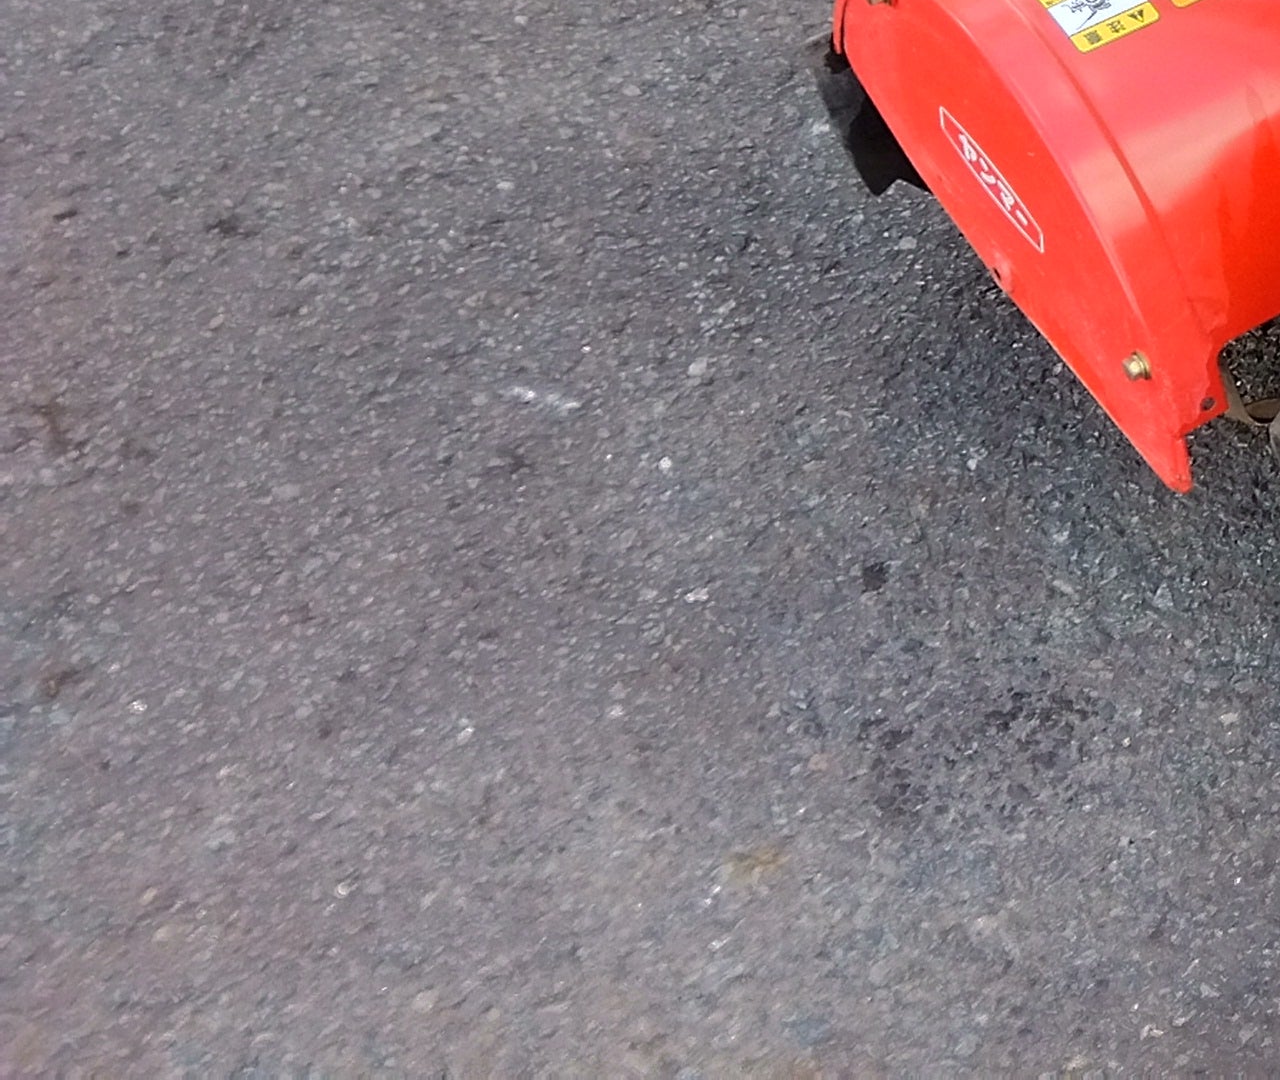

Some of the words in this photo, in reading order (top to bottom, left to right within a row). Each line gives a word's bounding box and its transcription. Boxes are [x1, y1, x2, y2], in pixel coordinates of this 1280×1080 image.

[1083, 20, 1126, 45] 注意
[958, 133, 1028, 227] ヤンマー
